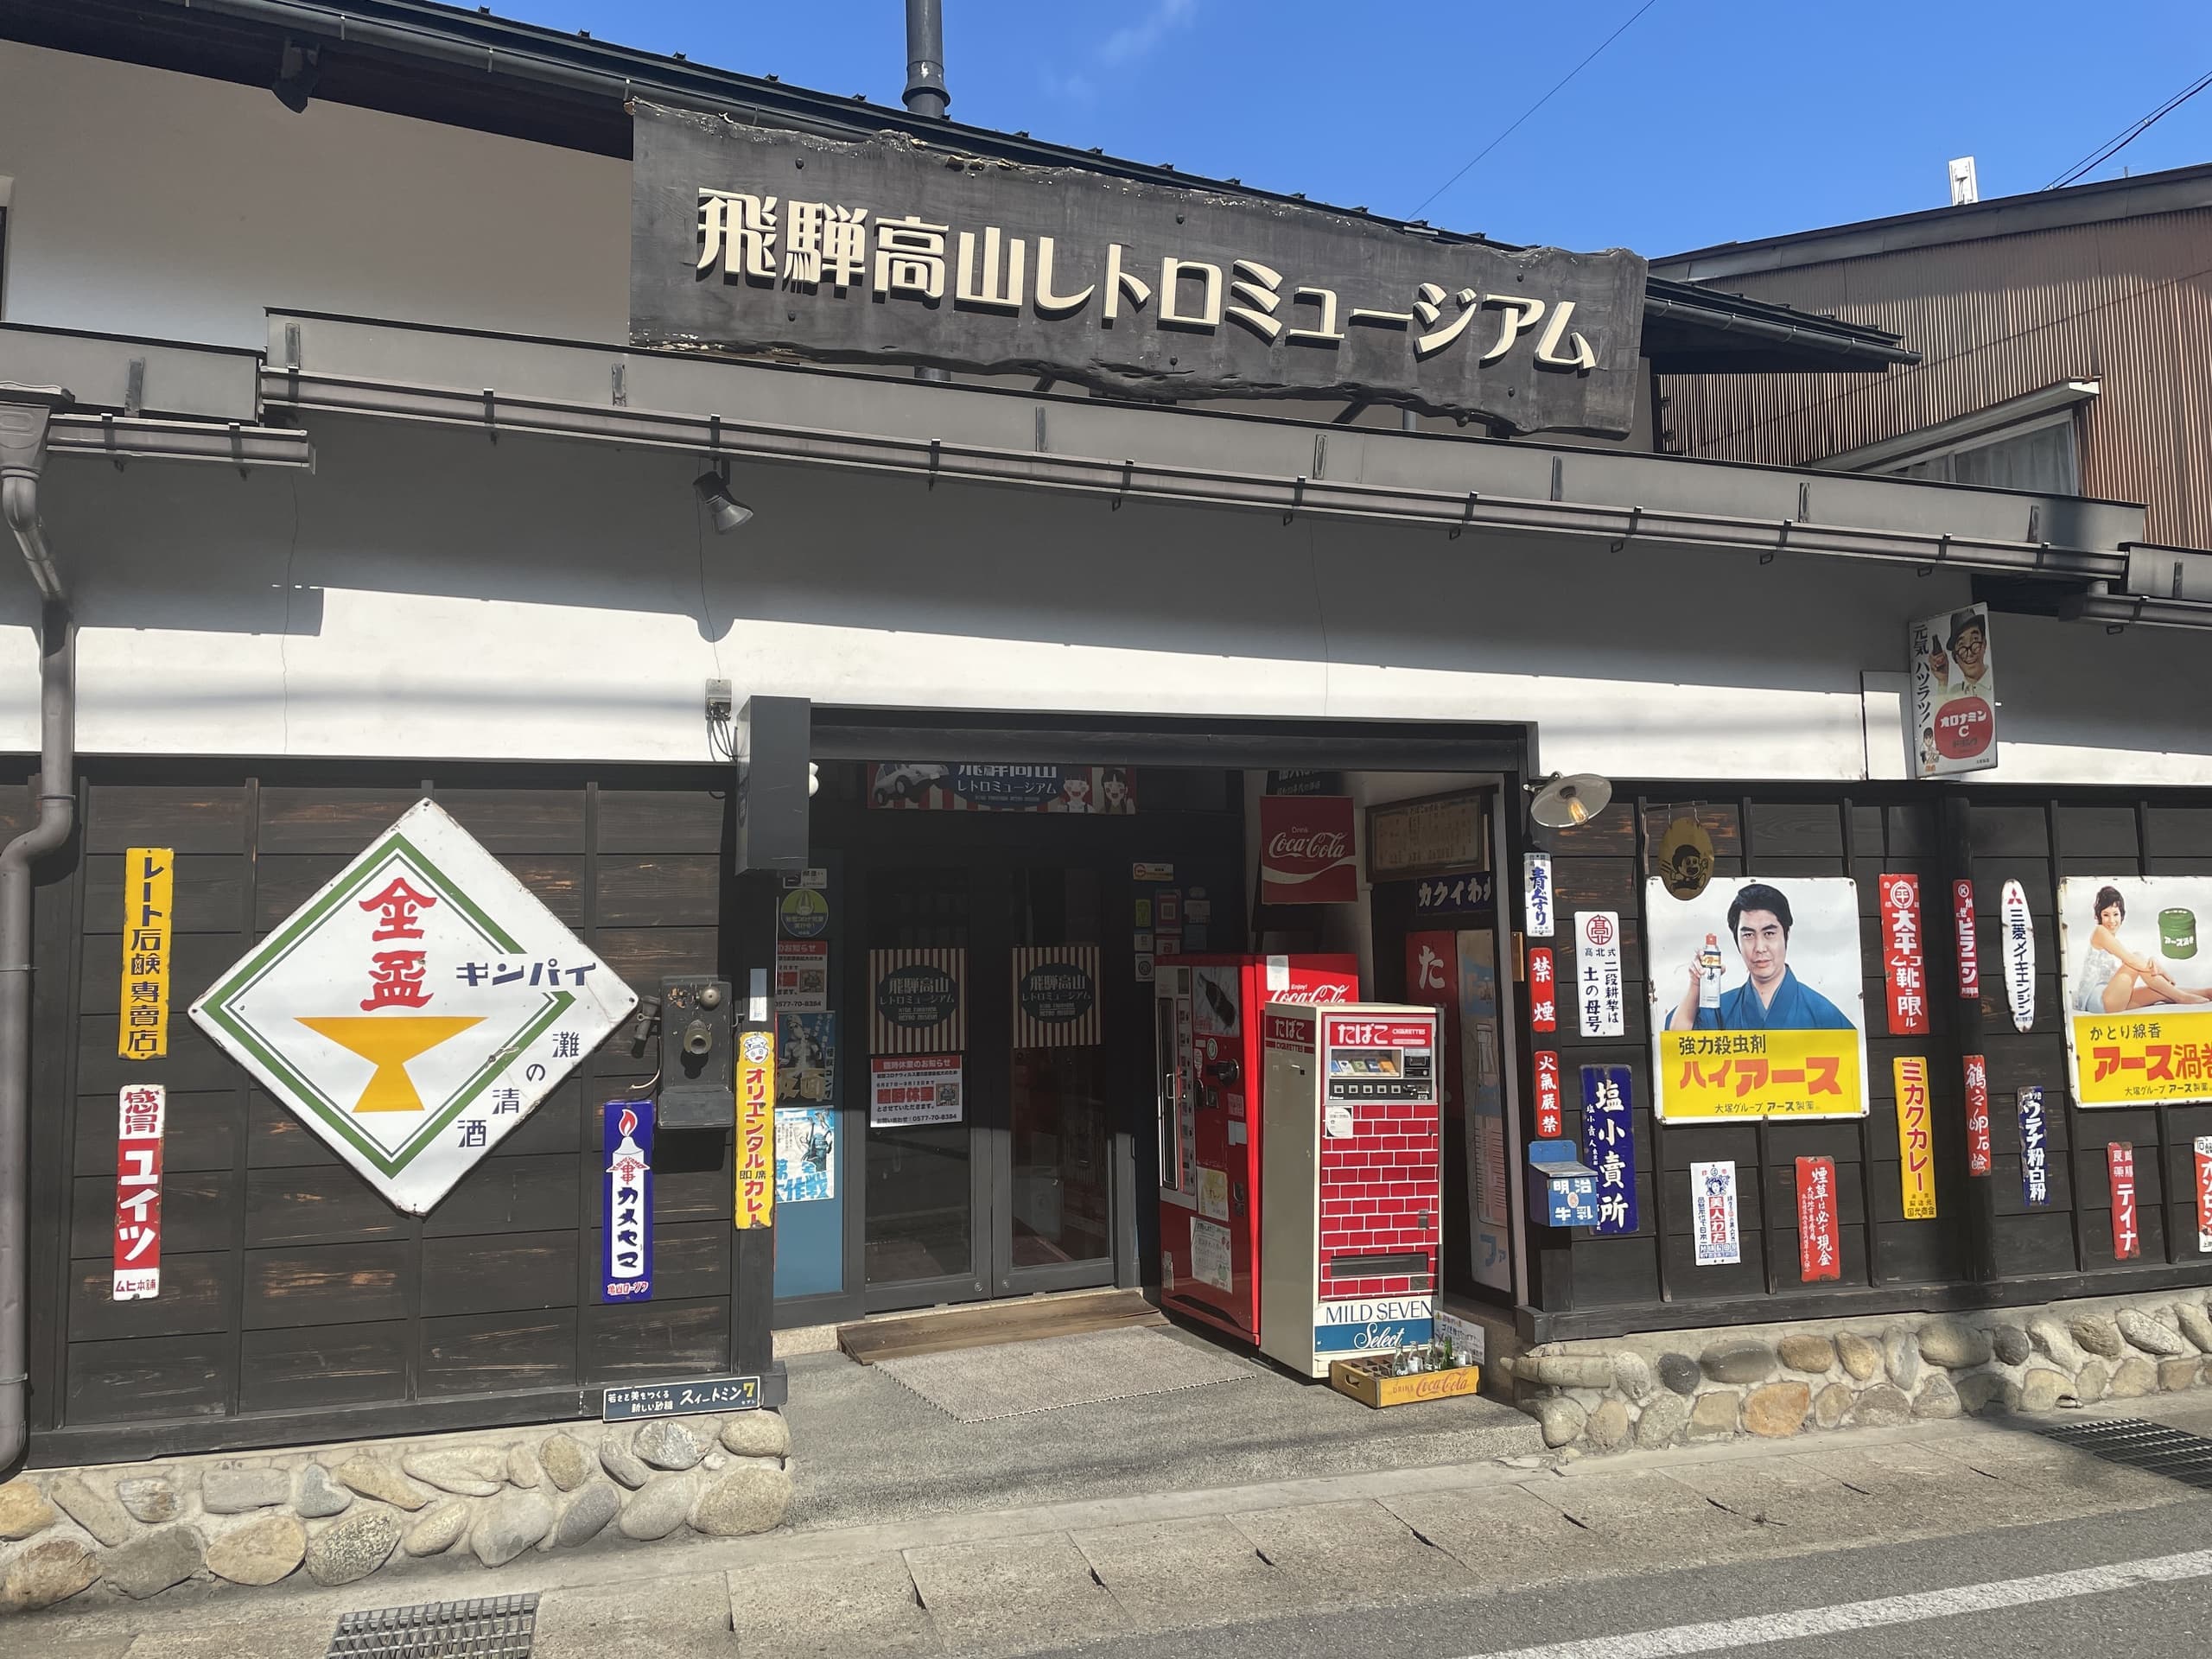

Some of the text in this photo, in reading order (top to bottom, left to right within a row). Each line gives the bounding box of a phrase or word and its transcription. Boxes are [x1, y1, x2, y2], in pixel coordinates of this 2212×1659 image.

[696, 188, 1597, 371] 飛騨高山レトロミュージアム
[1913, 624, 1929, 658] 元気
[1940, 710, 1986, 728] オロナミン
[1958, 726, 1969, 737] C
[957, 779, 1058, 795] レトロミュージアム
[1268, 832, 1349, 859] Coca-Cola
[359, 877, 437, 1012] 金盃
[1585, 948, 1616, 957] 高北式
[1958, 918, 1977, 984] ピラニン
[455, 958, 596, 987] キンパイ
[2010, 909, 2031, 1016] 三菱メイキエンジン
[888, 976, 950, 995] 飛騨高山
[1030, 975, 1086, 990] 飛騨高山
[1532, 957, 1555, 1021] 禁煙
[880, 994, 955, 1005] レトロミュージアム
[1022, 991, 1092, 1002] レトロミュージアム
[1275, 1019, 1305, 1040] たばこ
[1338, 1023, 1389, 1045] たばこ
[2090, 1022, 2161, 1040] かとり線香
[1679, 1034, 1766, 1055] 強力殺虫剤
[1680, 1057, 1842, 1097] ハイアース
[745, 1068, 766, 1169] オリエンタル
[1715, 1103, 1763, 1114] 大塚グループ
[1902, 1062, 1929, 1192] ミカクカレー
[2023, 1100, 2047, 1201] ウテナ粉白粉
[740, 1170, 766, 1180] 即席
[1553, 1179, 1592, 1194] 明治
[118, 1150, 159, 1262] ユイツ
[1554, 1205, 1593, 1221] 牛乳
[616, 1186, 640, 1269] カメヤマ
[1709, 1197, 1726, 1243] 美人わた
[1326, 1304, 1373, 1324] MILD
[1376, 1300, 1433, 1320] SEVEN
[1354, 1322, 1405, 1349] Select
[1416, 1369, 1467, 1397] Coca-Cola
[607, 1389, 670, 1404] 若さと美をつくる
[631, 1401, 674, 1414] 新しい砂糖
